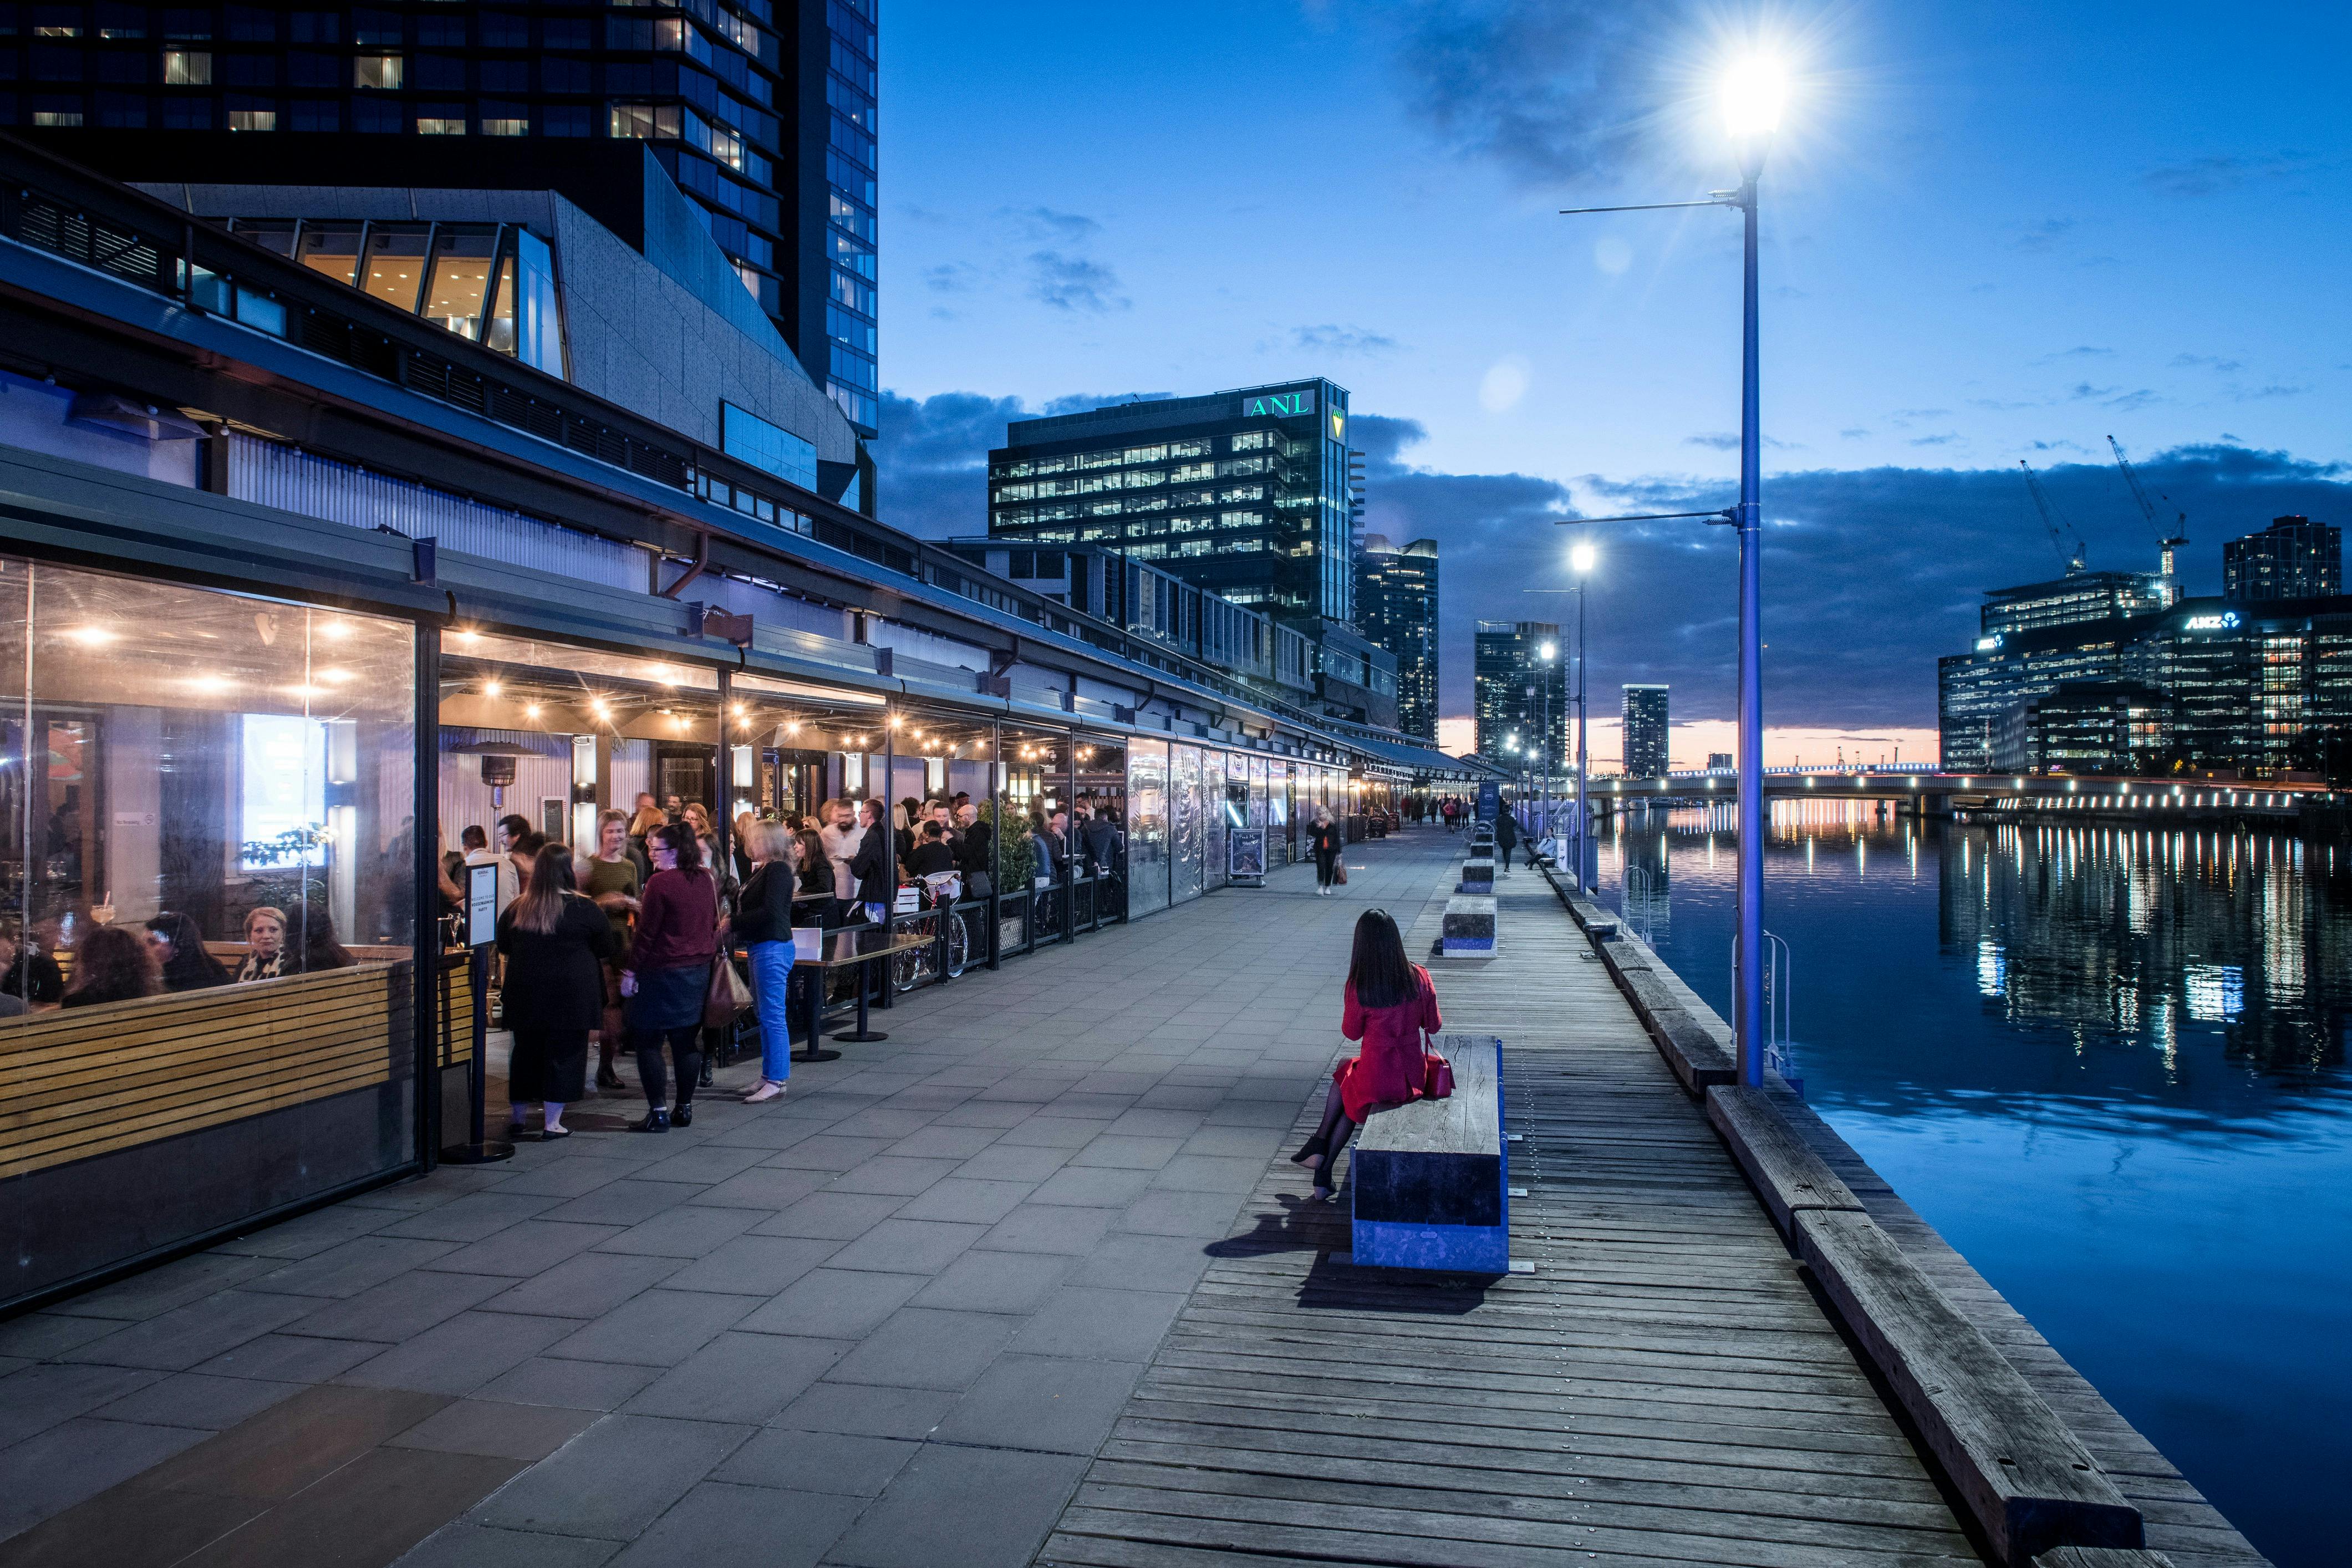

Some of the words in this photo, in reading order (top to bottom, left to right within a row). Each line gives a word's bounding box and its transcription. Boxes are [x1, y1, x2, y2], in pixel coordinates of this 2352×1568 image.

[1251, 394, 1309, 416] ANL
[1332, 409, 1343, 419] ANL
[2185, 616, 2222, 629] ANZ
